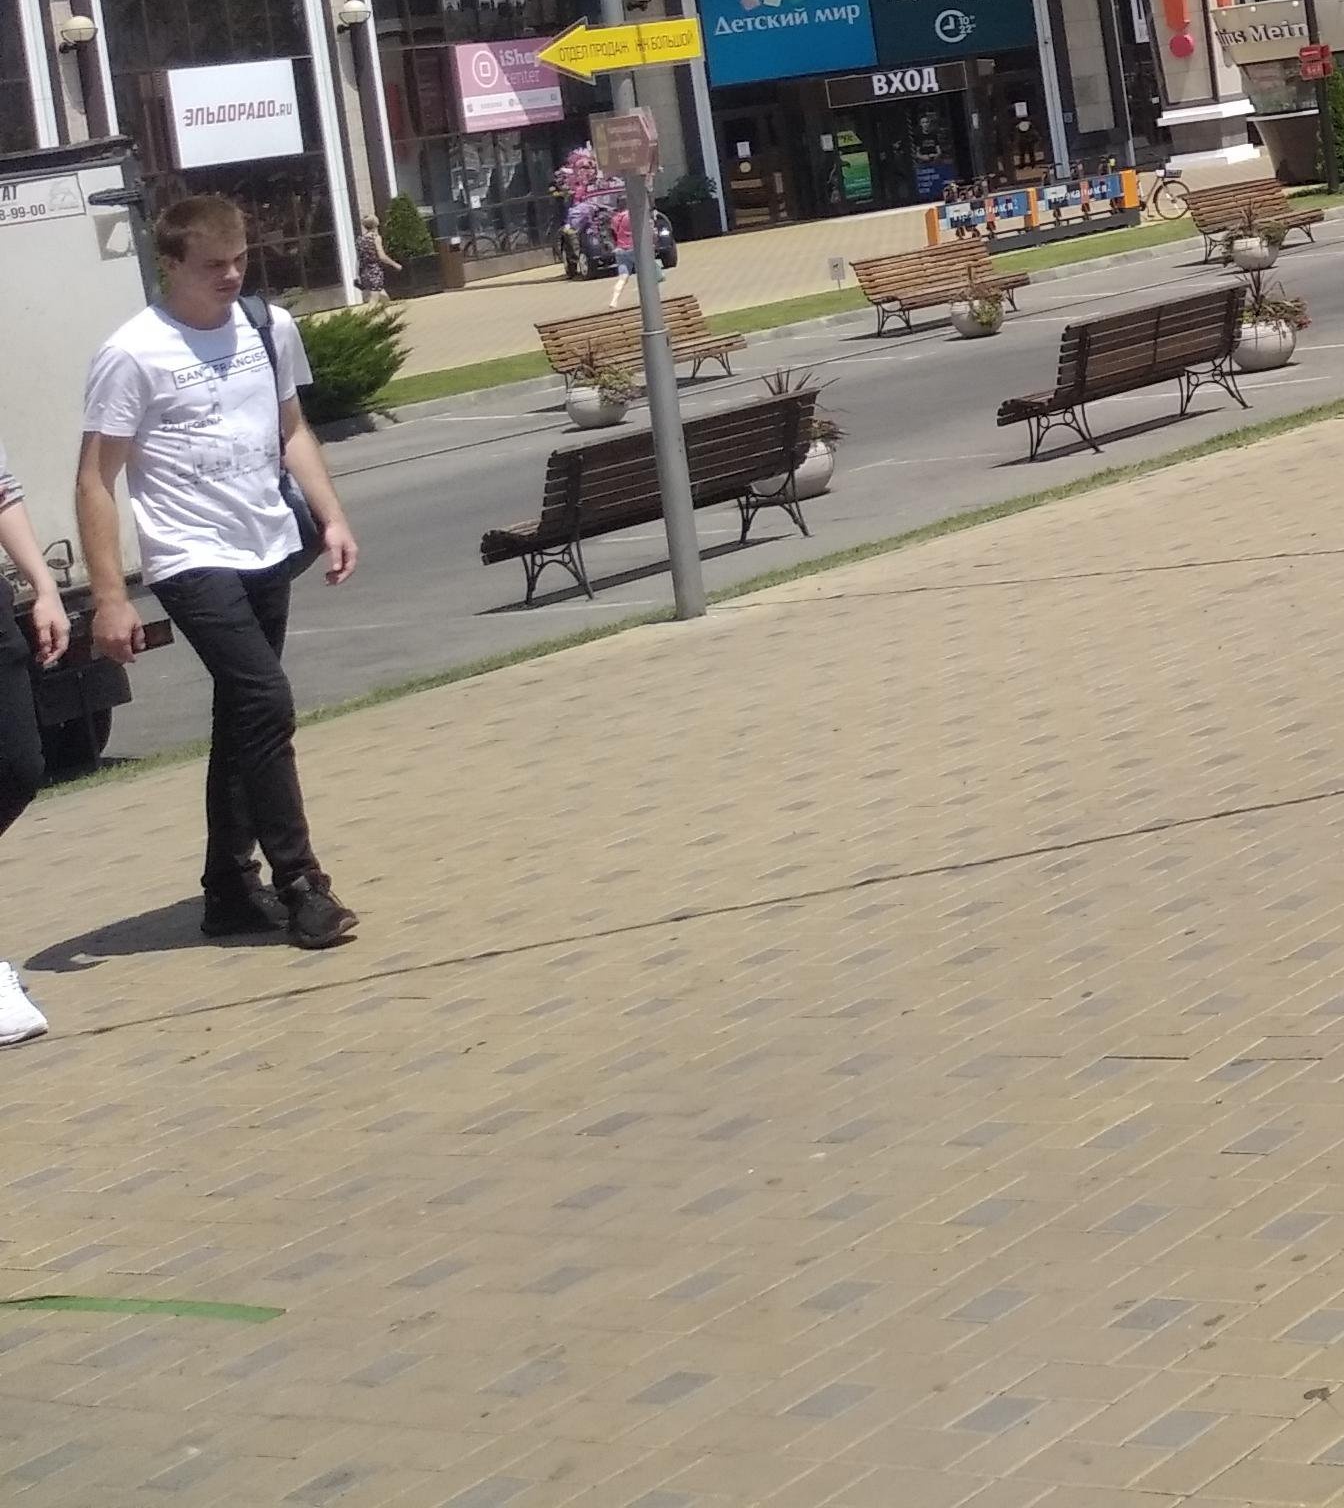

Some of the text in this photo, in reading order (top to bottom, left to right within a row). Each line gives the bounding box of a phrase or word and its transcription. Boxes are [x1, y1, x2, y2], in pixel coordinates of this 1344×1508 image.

[714, 2, 861, 37] Детский мир
[559, 44, 587, 63] ОТДЕЛ
[871, 66, 940, 98] ВХОД
[213, 350, 268, 374] FRANCISC
